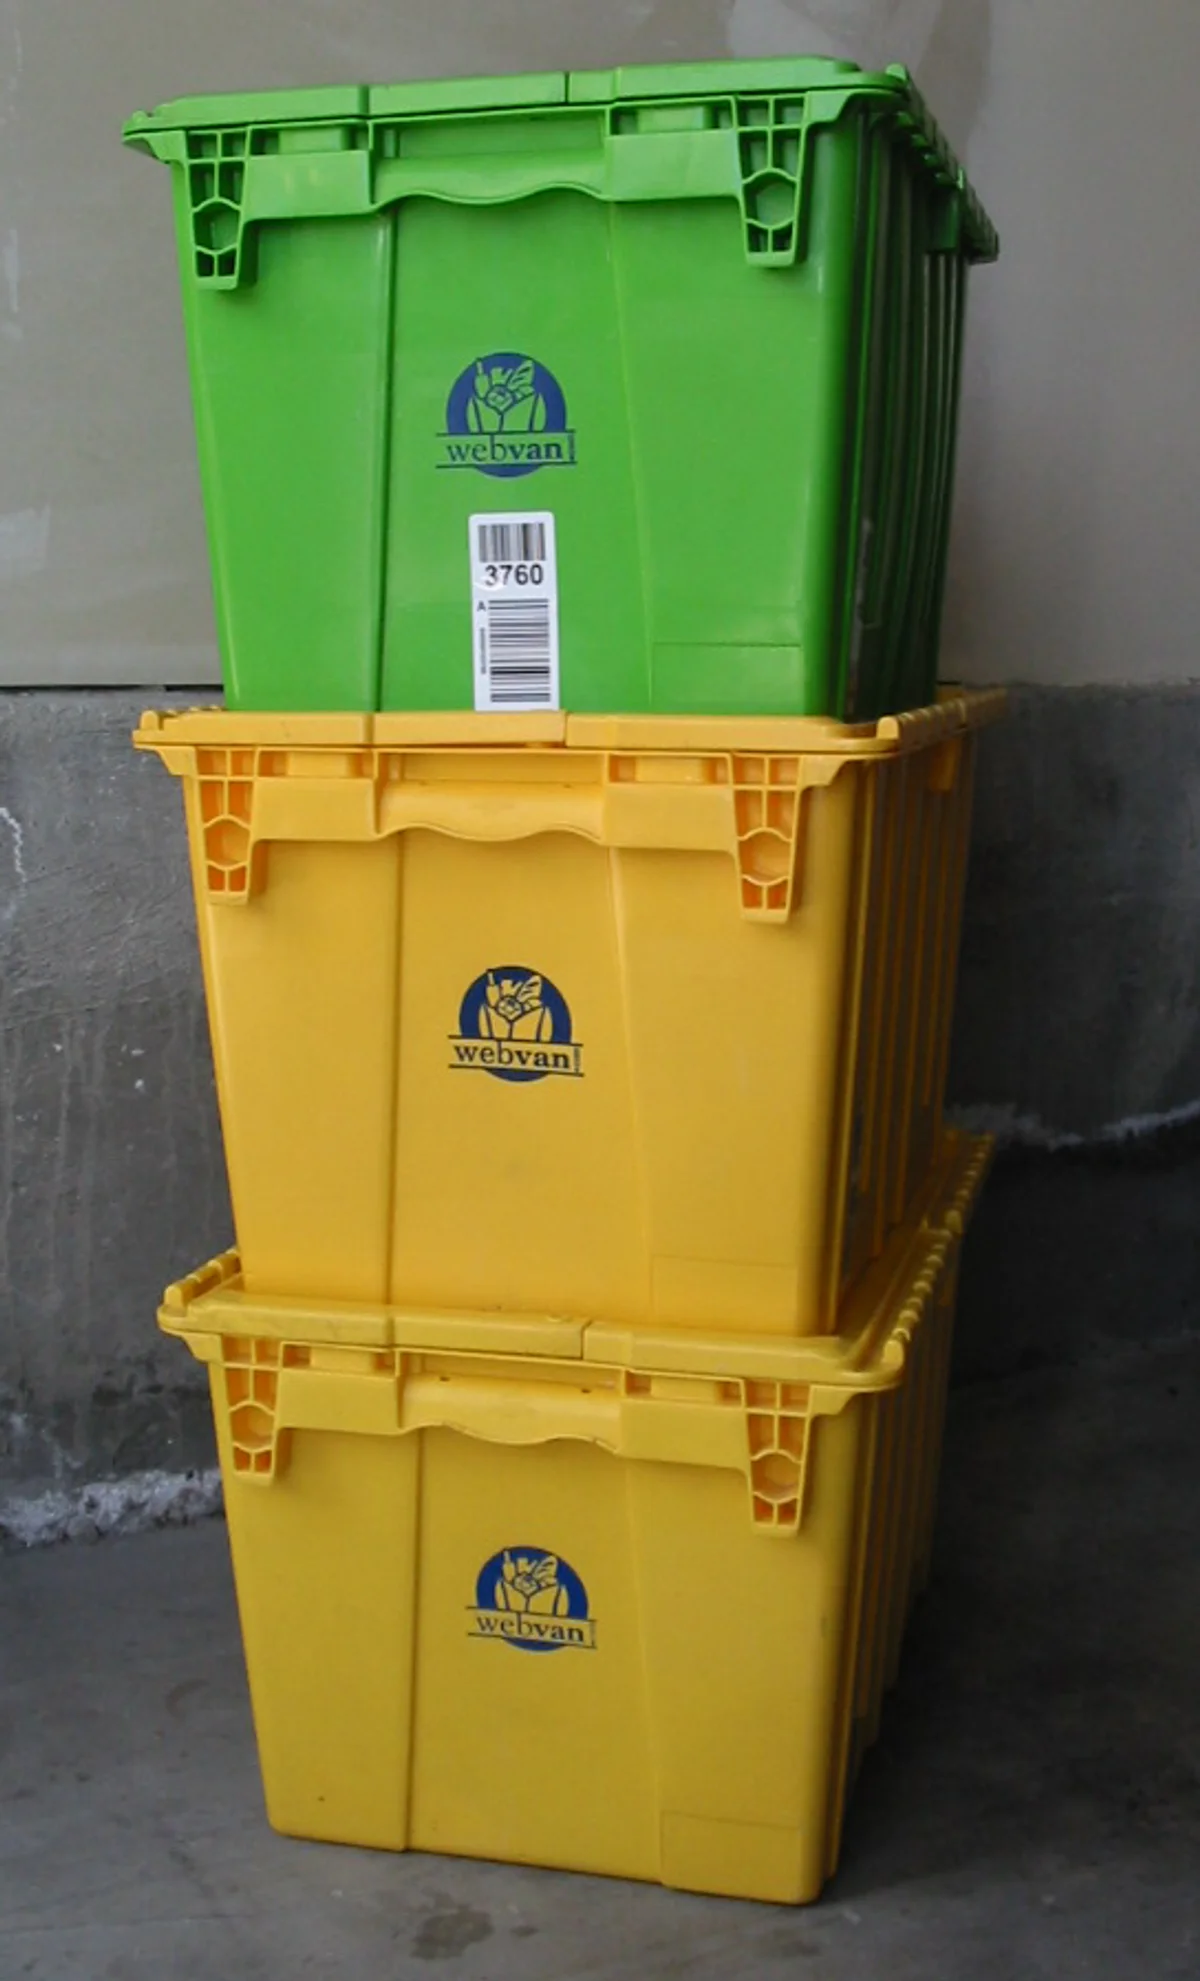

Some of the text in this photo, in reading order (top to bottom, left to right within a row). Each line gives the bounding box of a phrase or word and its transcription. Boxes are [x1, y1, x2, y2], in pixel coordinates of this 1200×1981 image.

[446, 433, 563, 462] webvan
[485, 563, 543, 586] 3760
[477, 601, 486, 612] A
[453, 1039, 570, 1069] webvan
[476, 1611, 584, 1642] webvan
